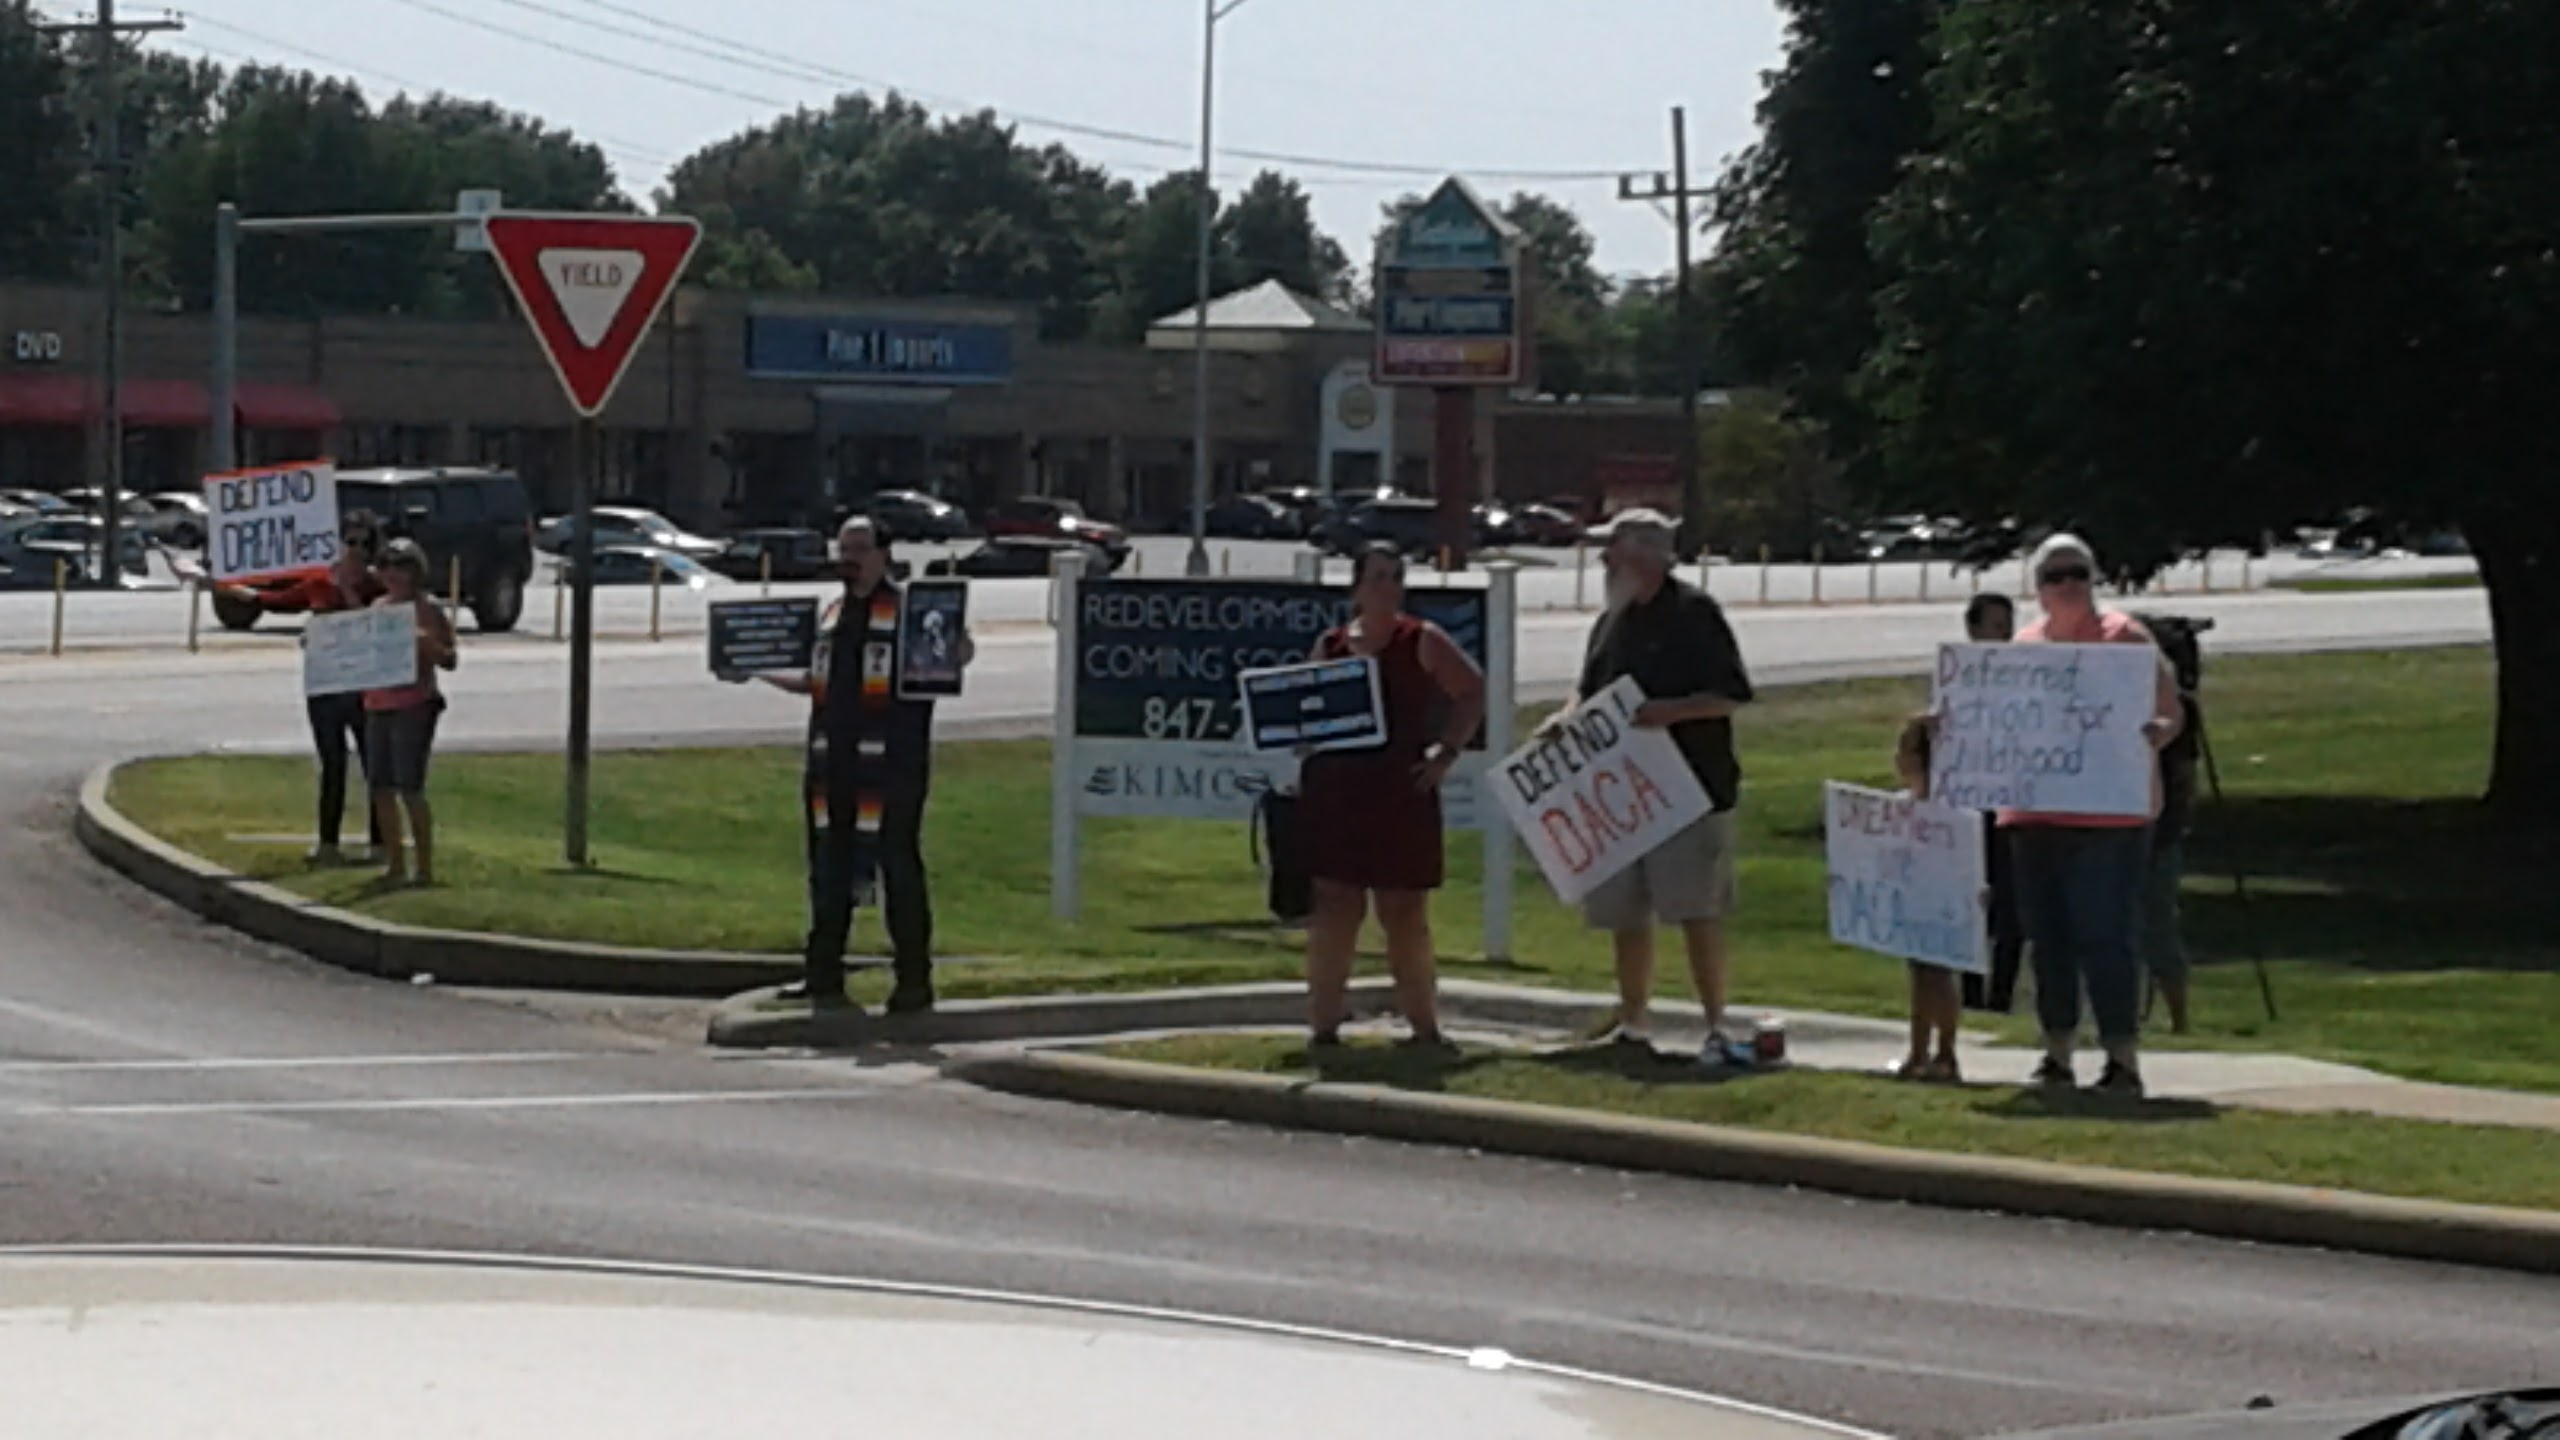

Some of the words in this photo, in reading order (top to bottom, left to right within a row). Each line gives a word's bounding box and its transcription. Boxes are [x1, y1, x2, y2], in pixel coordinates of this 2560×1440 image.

[561, 263, 622, 287] YIELD
[17, 331, 61, 359] DVD
[220, 470, 315, 513] DEFEND
[222, 514, 337, 572] DREAMers
[1085, 594, 1352, 634] REDEVELOPMENT
[1086, 644, 1226, 681] COMING
[1938, 646, 2081, 692] Deferred
[2062, 700, 2113, 733] for
[1507, 709, 1620, 804] DEFEND
[1541, 754, 1673, 875] DACA
